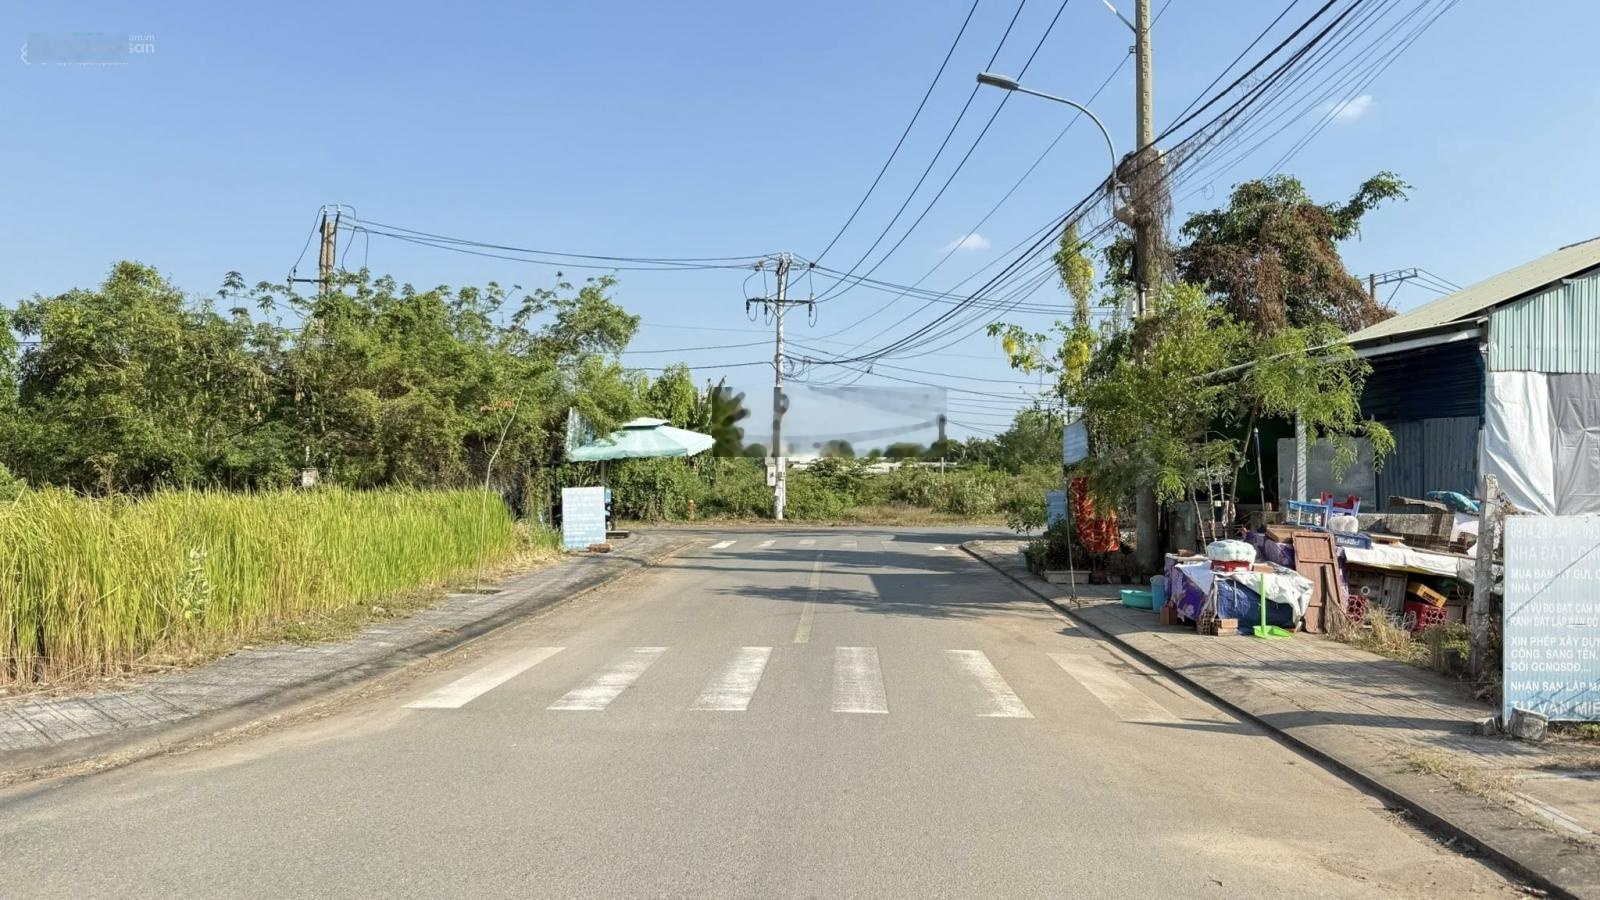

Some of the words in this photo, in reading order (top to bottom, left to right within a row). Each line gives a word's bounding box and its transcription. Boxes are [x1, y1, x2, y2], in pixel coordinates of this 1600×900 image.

[1511, 636, 1527, 647] XIN
[1530, 634, 1557, 647] PHÉP
[1559, 634, 1579, 647] XÂY
[1546, 649, 1573, 660] SANG
[1543, 681, 1564, 691] SAN
